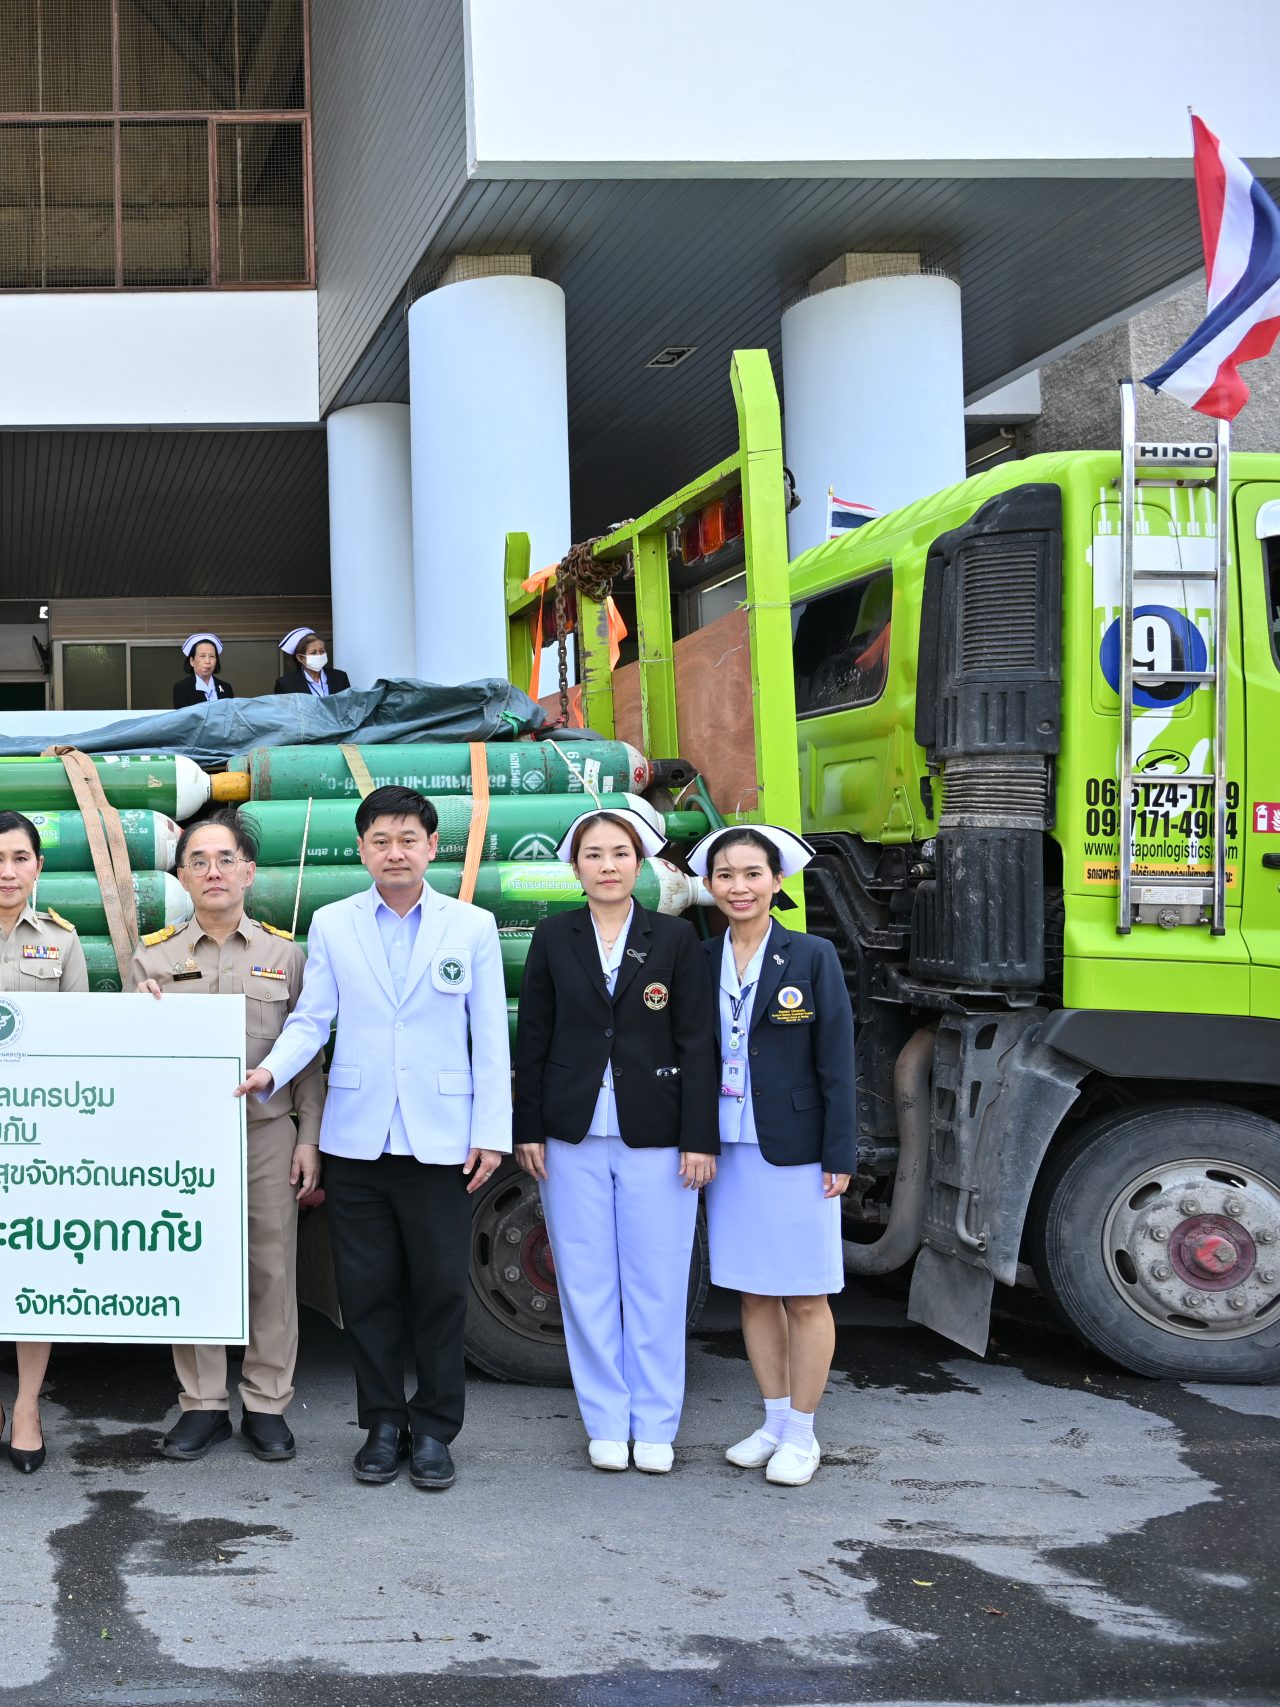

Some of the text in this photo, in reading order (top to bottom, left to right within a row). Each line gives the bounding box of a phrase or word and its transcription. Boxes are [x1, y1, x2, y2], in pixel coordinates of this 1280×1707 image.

[1140, 446, 1213, 458] HINO
[1131, 615, 1175, 689] 9
[15, 1287, 180, 1318] จังหวัดสงขลา
